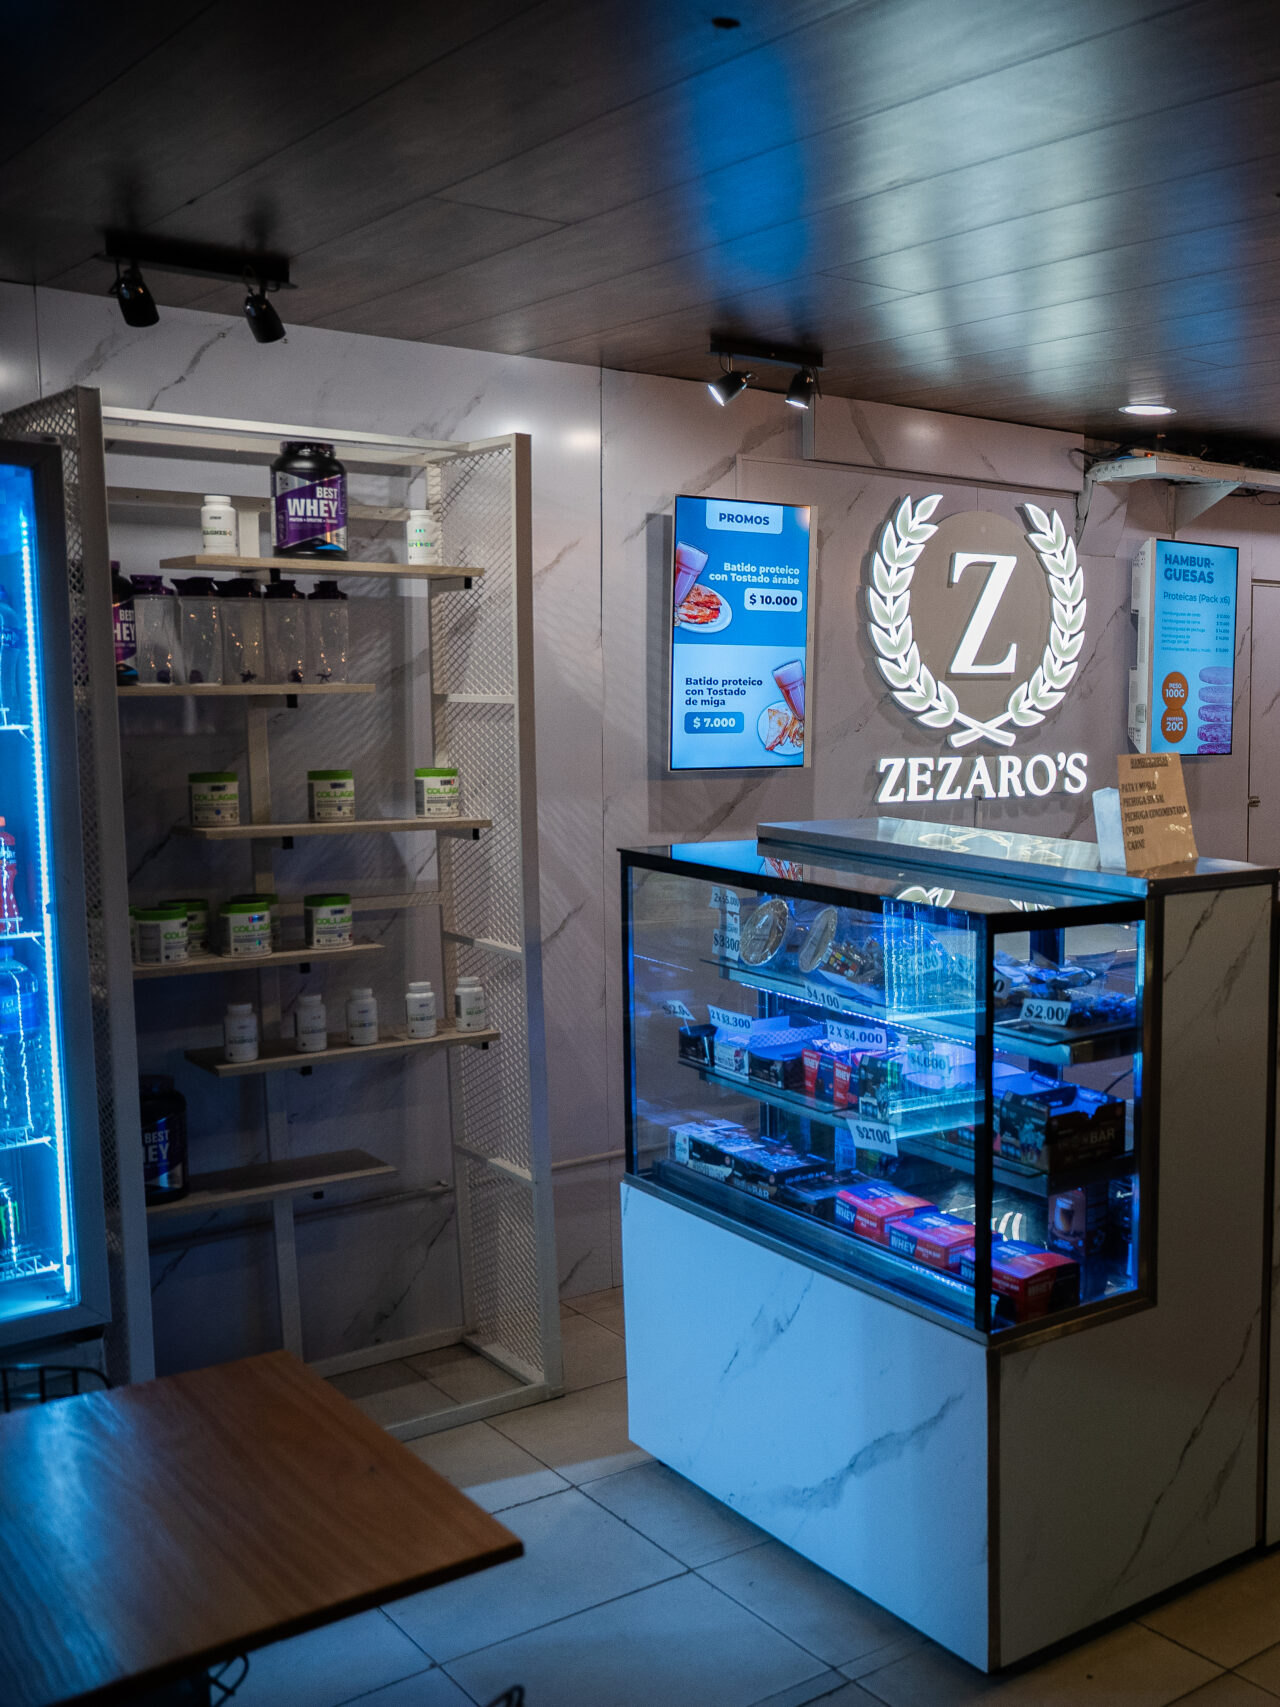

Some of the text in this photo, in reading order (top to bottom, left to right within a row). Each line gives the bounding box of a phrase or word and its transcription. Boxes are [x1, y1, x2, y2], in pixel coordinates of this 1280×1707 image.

[316, 487, 338, 499] BEST
[287, 498, 338, 517] WHEY
[718, 512, 770, 526] PROMOS
[1164, 553, 1215, 569] HAMBUR-
[723, 562, 800, 577] Batido proteico
[1163, 568, 1214, 584] GUESAS
[709, 573, 800, 585] con Tostado árabe
[749, 594, 798, 606] $ 10.000
[949, 551, 1018, 675] Z
[113, 622, 136, 641] HEY
[685, 677, 763, 688] Batido proteico
[706, 687, 747, 696] Tostado
[1165, 688, 1185, 698] 100G
[685, 697, 726, 708] de miga
[693, 716, 736, 729] $ 7.000
[1166, 721, 1184, 732] 20G
[876, 751, 1089, 804] ZEZARO'S
[806, 985, 840, 1010] $4.100
[721, 1013, 751, 1029] $3.300
[829, 1024, 883, 1044] 2 X $4.000
[835, 1067, 851, 1081] WHEY
[144, 1129, 170, 1144] BEST
[856, 1125, 892, 1144] $2700
[835, 1204, 856, 1223] WHEY
[890, 1235, 916, 1255] WHEY
